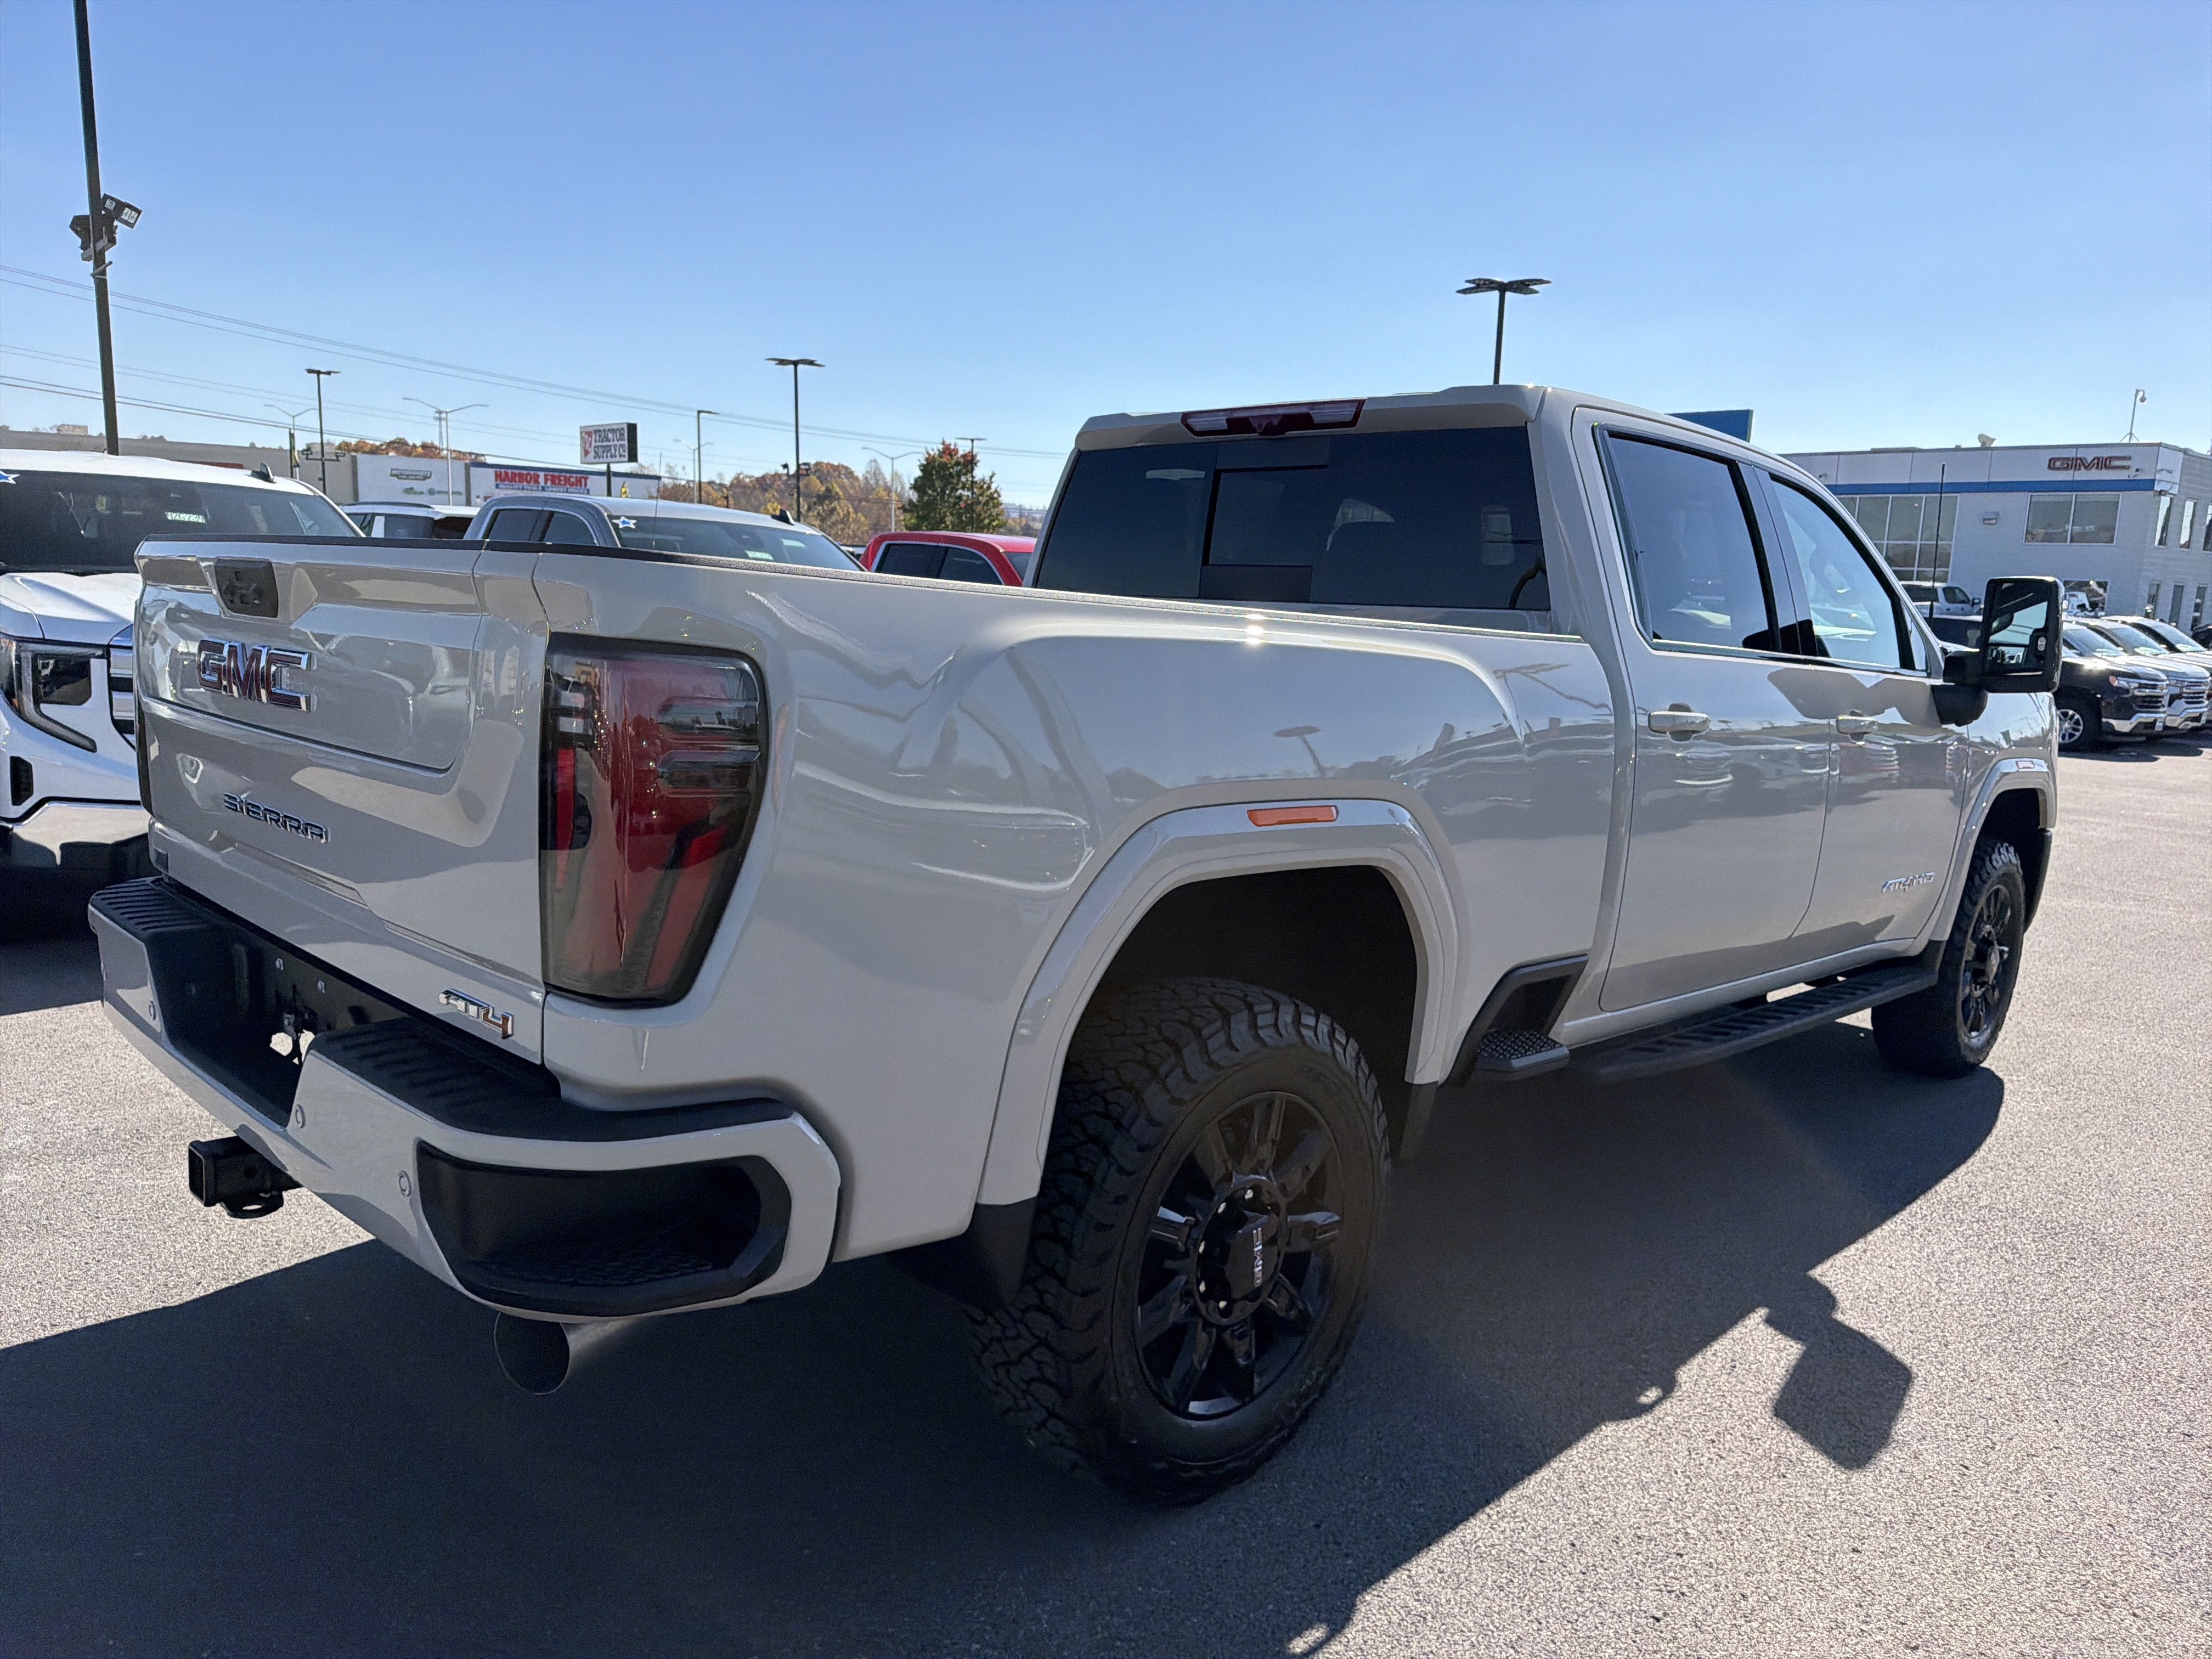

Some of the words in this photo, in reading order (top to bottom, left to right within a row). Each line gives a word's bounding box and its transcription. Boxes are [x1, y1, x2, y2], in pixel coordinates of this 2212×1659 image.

[593, 427, 625, 443] TRACTOR
[593, 444, 618, 459] SUPPLY
[494, 470, 540, 484] HARBOR
[544, 473, 589, 488] FREIGHT
[2047, 455, 2131, 471] GMC
[196, 637, 312, 713] GMC
[223, 792, 329, 844] SIERRA
[439, 988, 514, 1040] AT4
[1252, 1227, 1263, 1288] GMC
